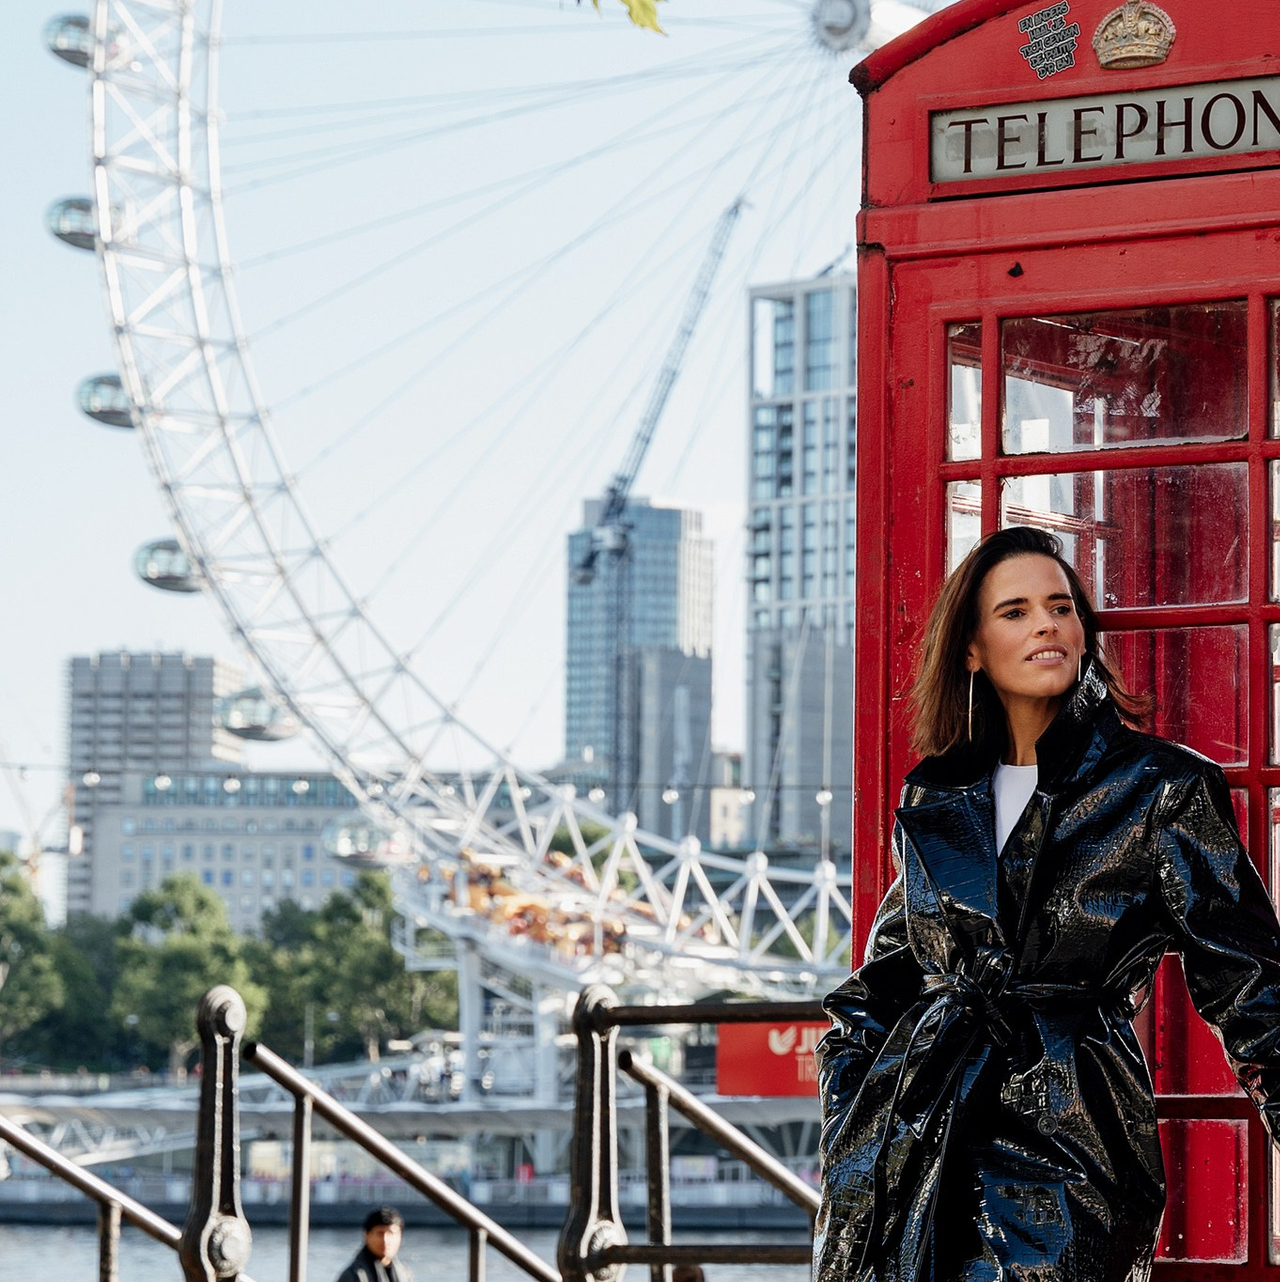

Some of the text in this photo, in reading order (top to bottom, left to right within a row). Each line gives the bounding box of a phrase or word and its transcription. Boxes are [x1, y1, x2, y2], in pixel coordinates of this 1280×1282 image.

[1019, 1, 1069, 32] EN ANDERS
[1052, 17, 1066, 31] JE
[1044, 24, 1080, 48] GEWOON
[1030, 53, 1045, 68] DE
